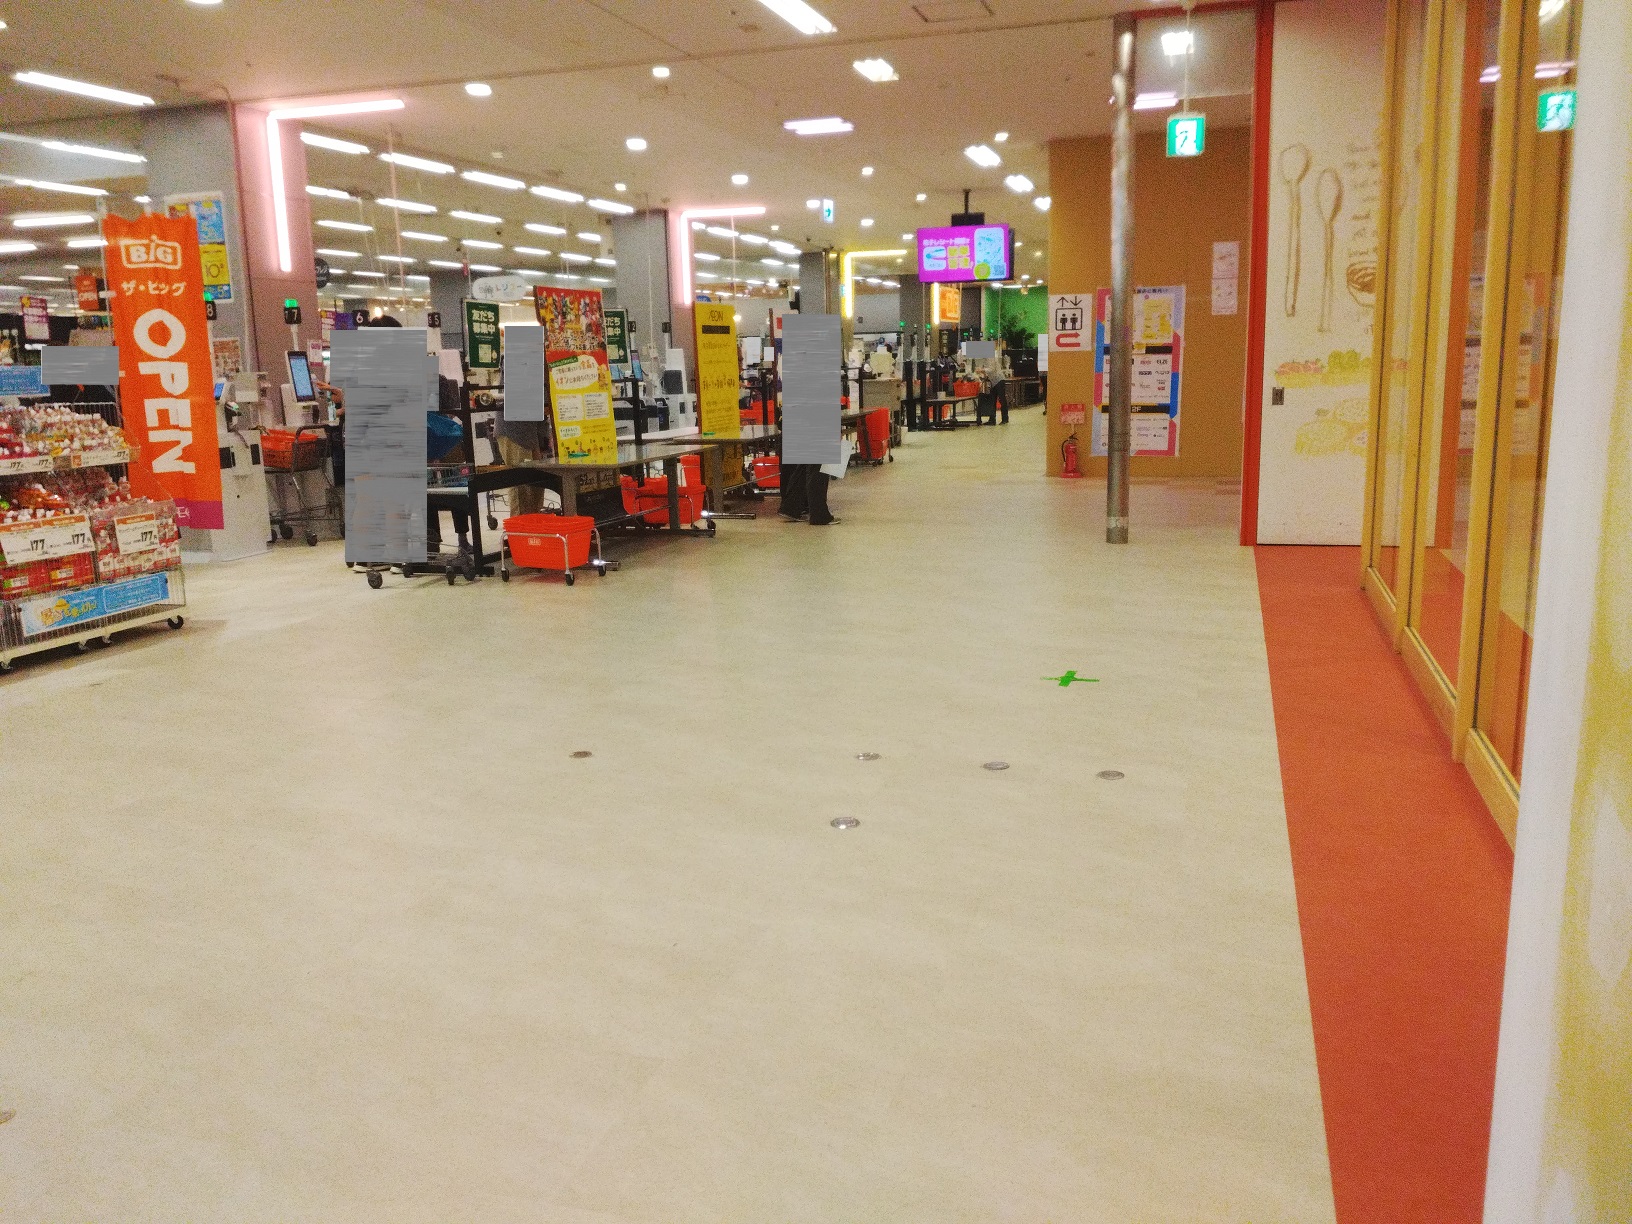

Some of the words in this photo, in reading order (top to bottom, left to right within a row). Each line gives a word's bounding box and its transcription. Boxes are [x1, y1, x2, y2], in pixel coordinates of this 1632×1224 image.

[121, 280, 187, 297] ザ・ビッグ
[207, 303, 214, 317] 8
[292, 309, 298, 321] 7
[472, 310, 495, 322] 友だち
[355, 314, 364, 324] 6
[434, 314, 440, 325] 5
[133, 308, 196, 474] OPEN
[71, 532, 87, 546] 177
[141, 530, 154, 542] 177
[30, 538, 46, 552] 177
